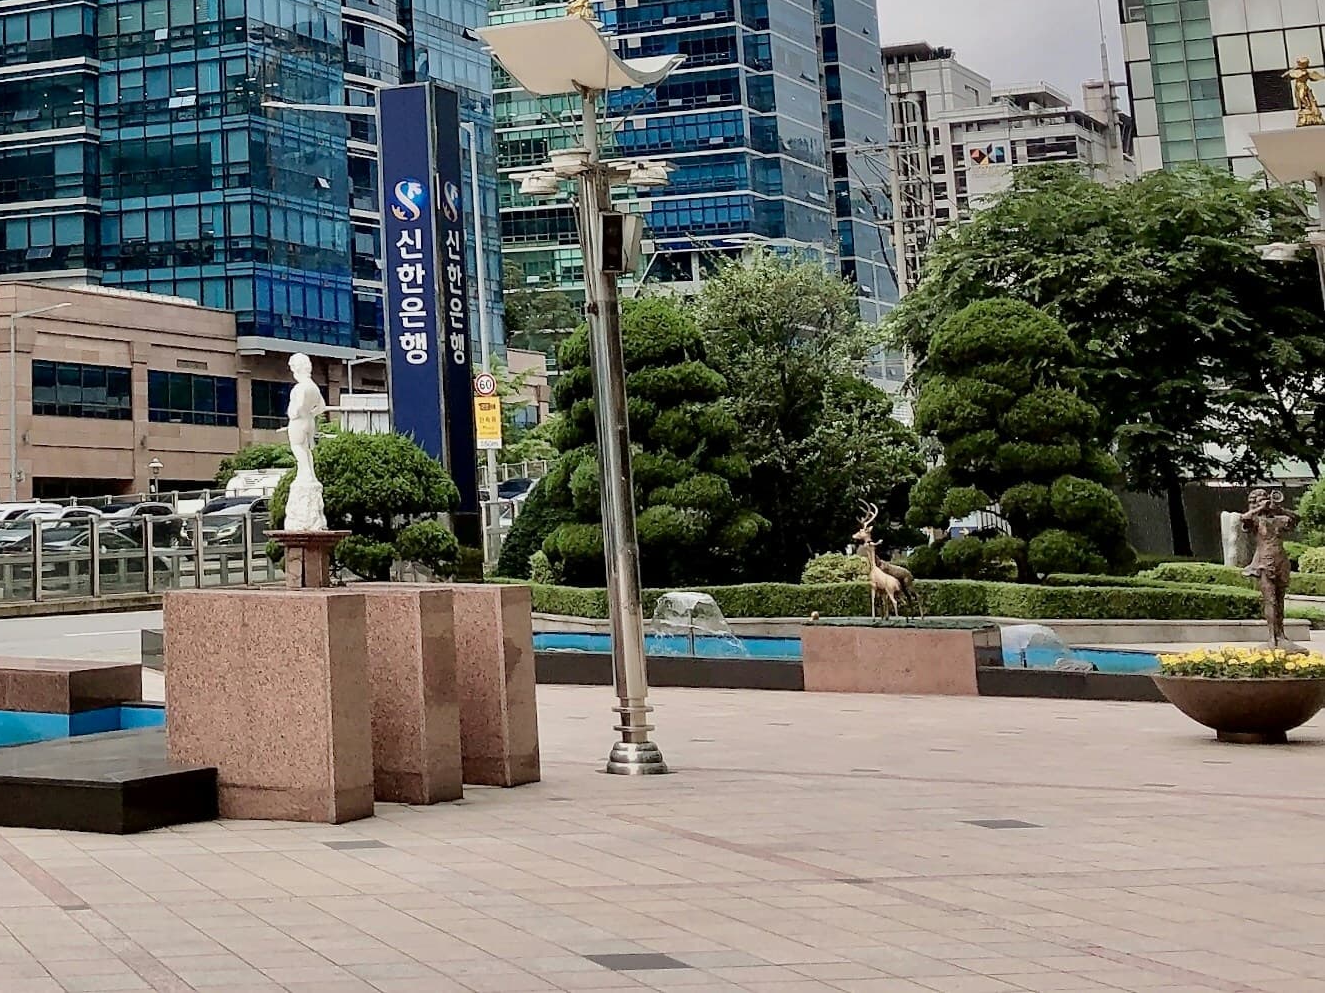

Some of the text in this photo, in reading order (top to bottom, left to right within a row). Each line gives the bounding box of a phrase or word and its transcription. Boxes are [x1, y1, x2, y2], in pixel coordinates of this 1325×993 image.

[396, 228, 428, 365] 신한은행
[446, 229, 465, 365] 신한은행
[479, 380, 492, 390] 60
